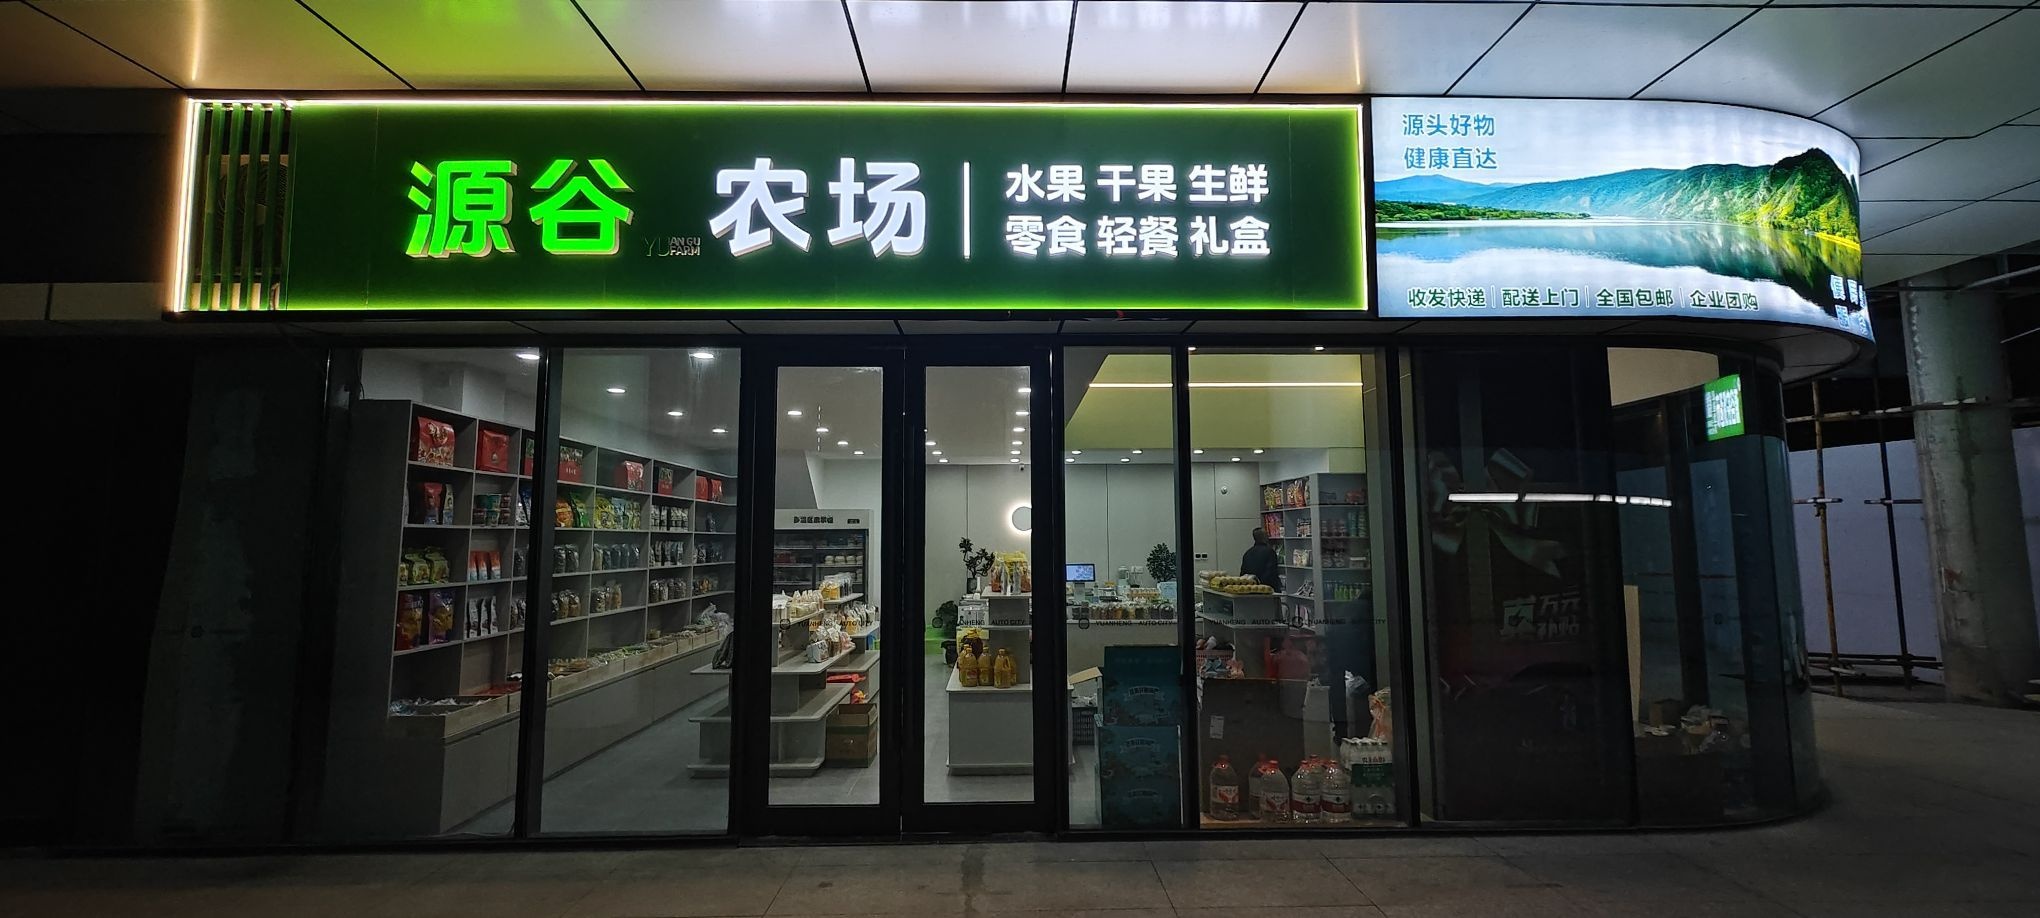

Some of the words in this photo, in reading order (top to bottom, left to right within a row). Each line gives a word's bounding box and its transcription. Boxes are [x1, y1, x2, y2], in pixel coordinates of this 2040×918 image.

[1402, 113, 1495, 137] 源头好物
[1404, 147, 1498, 170] 健康直达
[1004, 162, 1087, 203] 水果
[1096, 163, 1178, 203] 干果
[1187, 163, 1271, 203] 生鲜
[405, 158, 635, 259] 源谷
[708, 156, 927, 258] 农场
[1004, 214, 1088, 256] 零食
[1096, 214, 1179, 257] 轻餐
[1188, 214, 1271, 257] 礼盒
[1407, 287, 1487, 308] 收发快递
[1501, 287, 1580, 308] 配送上门
[1596, 287, 1674, 308] 全国包邮
[1689, 288, 1760, 311] 企业团购
